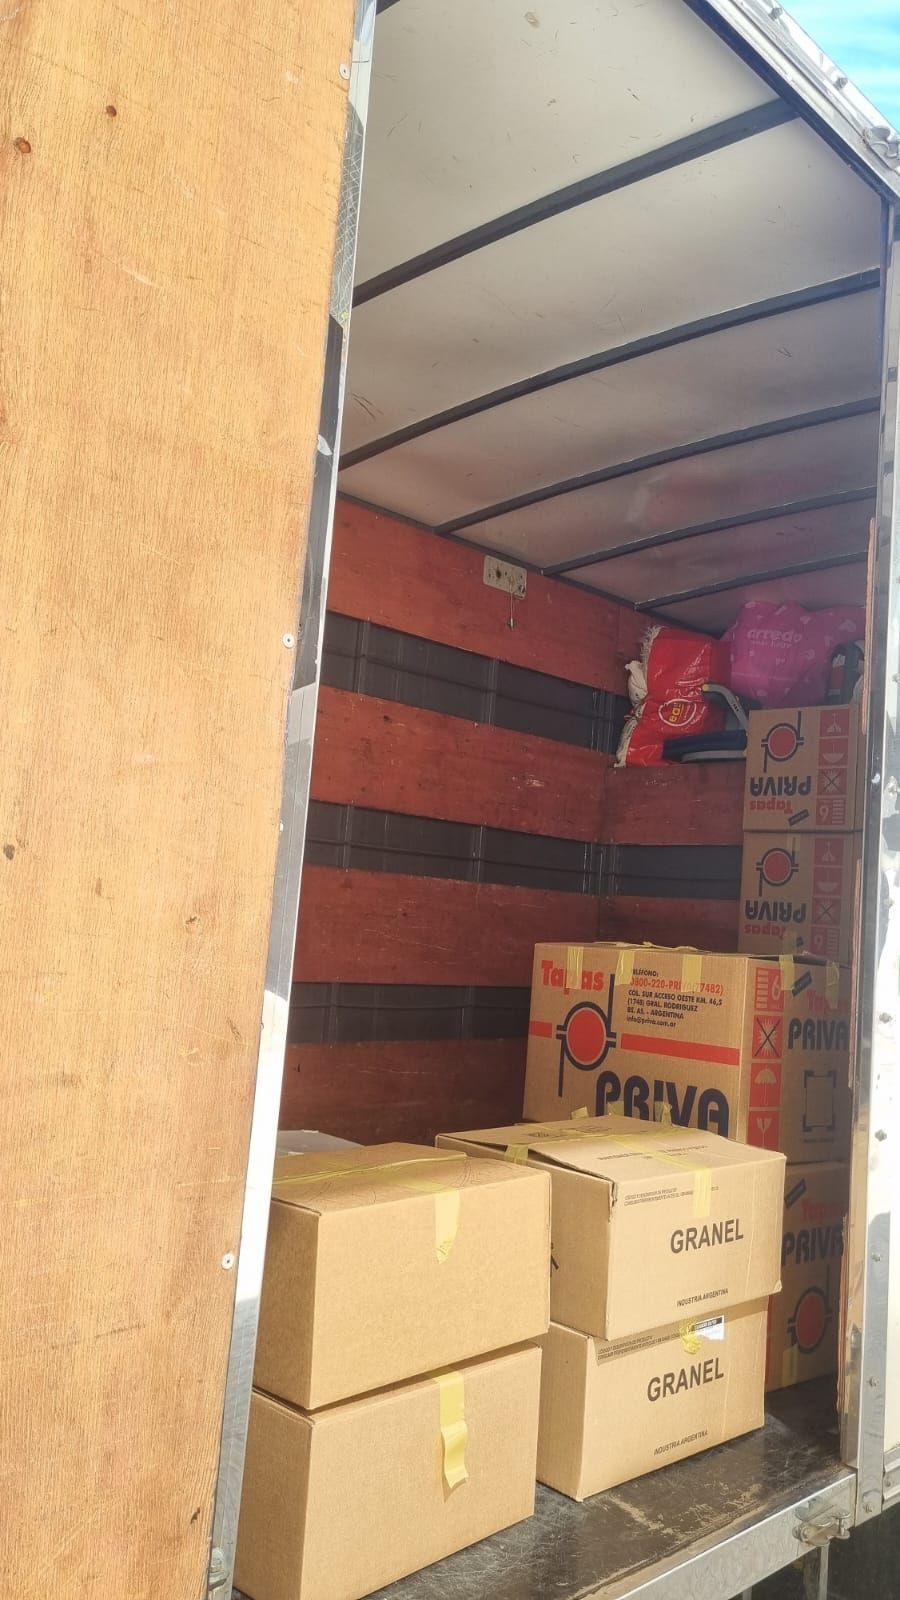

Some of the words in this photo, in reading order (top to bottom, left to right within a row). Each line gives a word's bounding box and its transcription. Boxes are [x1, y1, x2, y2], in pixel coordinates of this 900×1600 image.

[747, 629, 803, 643] arredo
[750, 776, 812, 796] PRIVA
[749, 797, 793, 814] Tapas
[744, 901, 807, 923] PRIVA
[654, 992, 676, 1001] ACCESO
[650, 1010, 685, 1019] ARGENTINA
[787, 1017, 848, 1051] PRIVA
[595, 1070, 730, 1138] PRIVA
[670, 1218, 744, 1254] GRANEL
[647, 1357, 724, 1402] GRANEL
